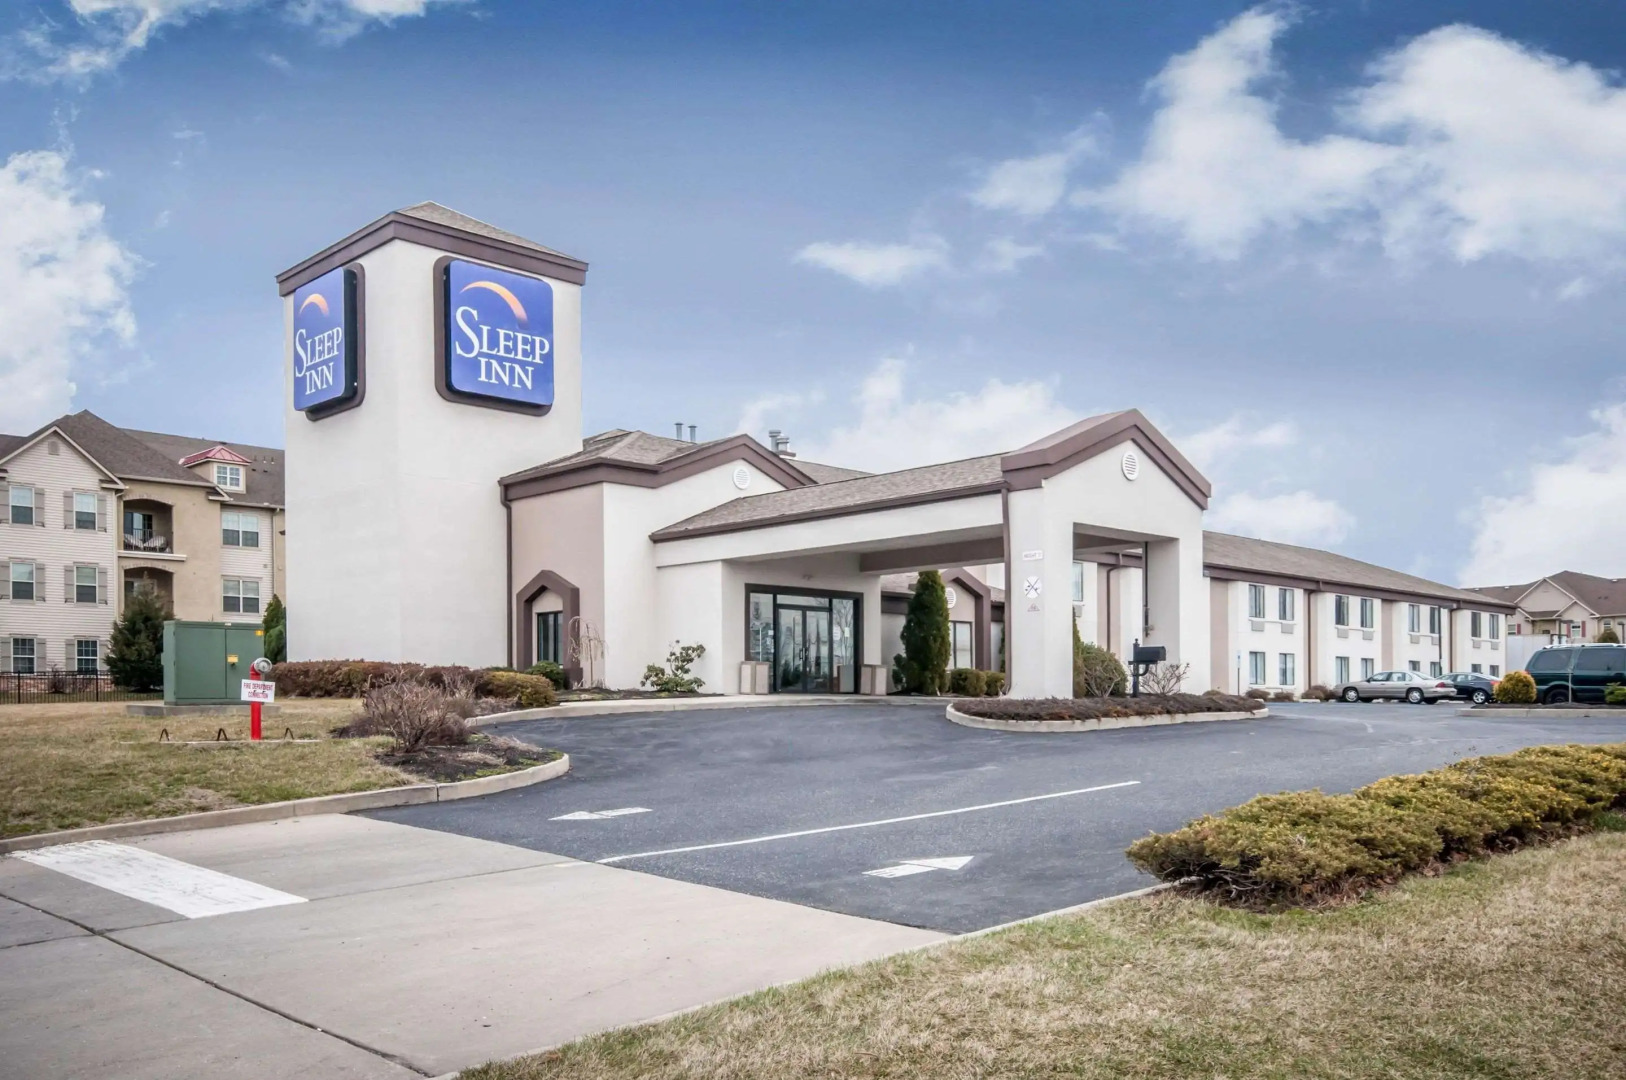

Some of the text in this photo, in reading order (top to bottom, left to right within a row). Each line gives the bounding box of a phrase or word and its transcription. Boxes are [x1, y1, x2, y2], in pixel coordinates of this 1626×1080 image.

[295, 326, 342, 378] SLEEP
[455, 306, 550, 364] SLEEP
[305, 362, 334, 395] INN
[477, 356, 534, 390] INN
